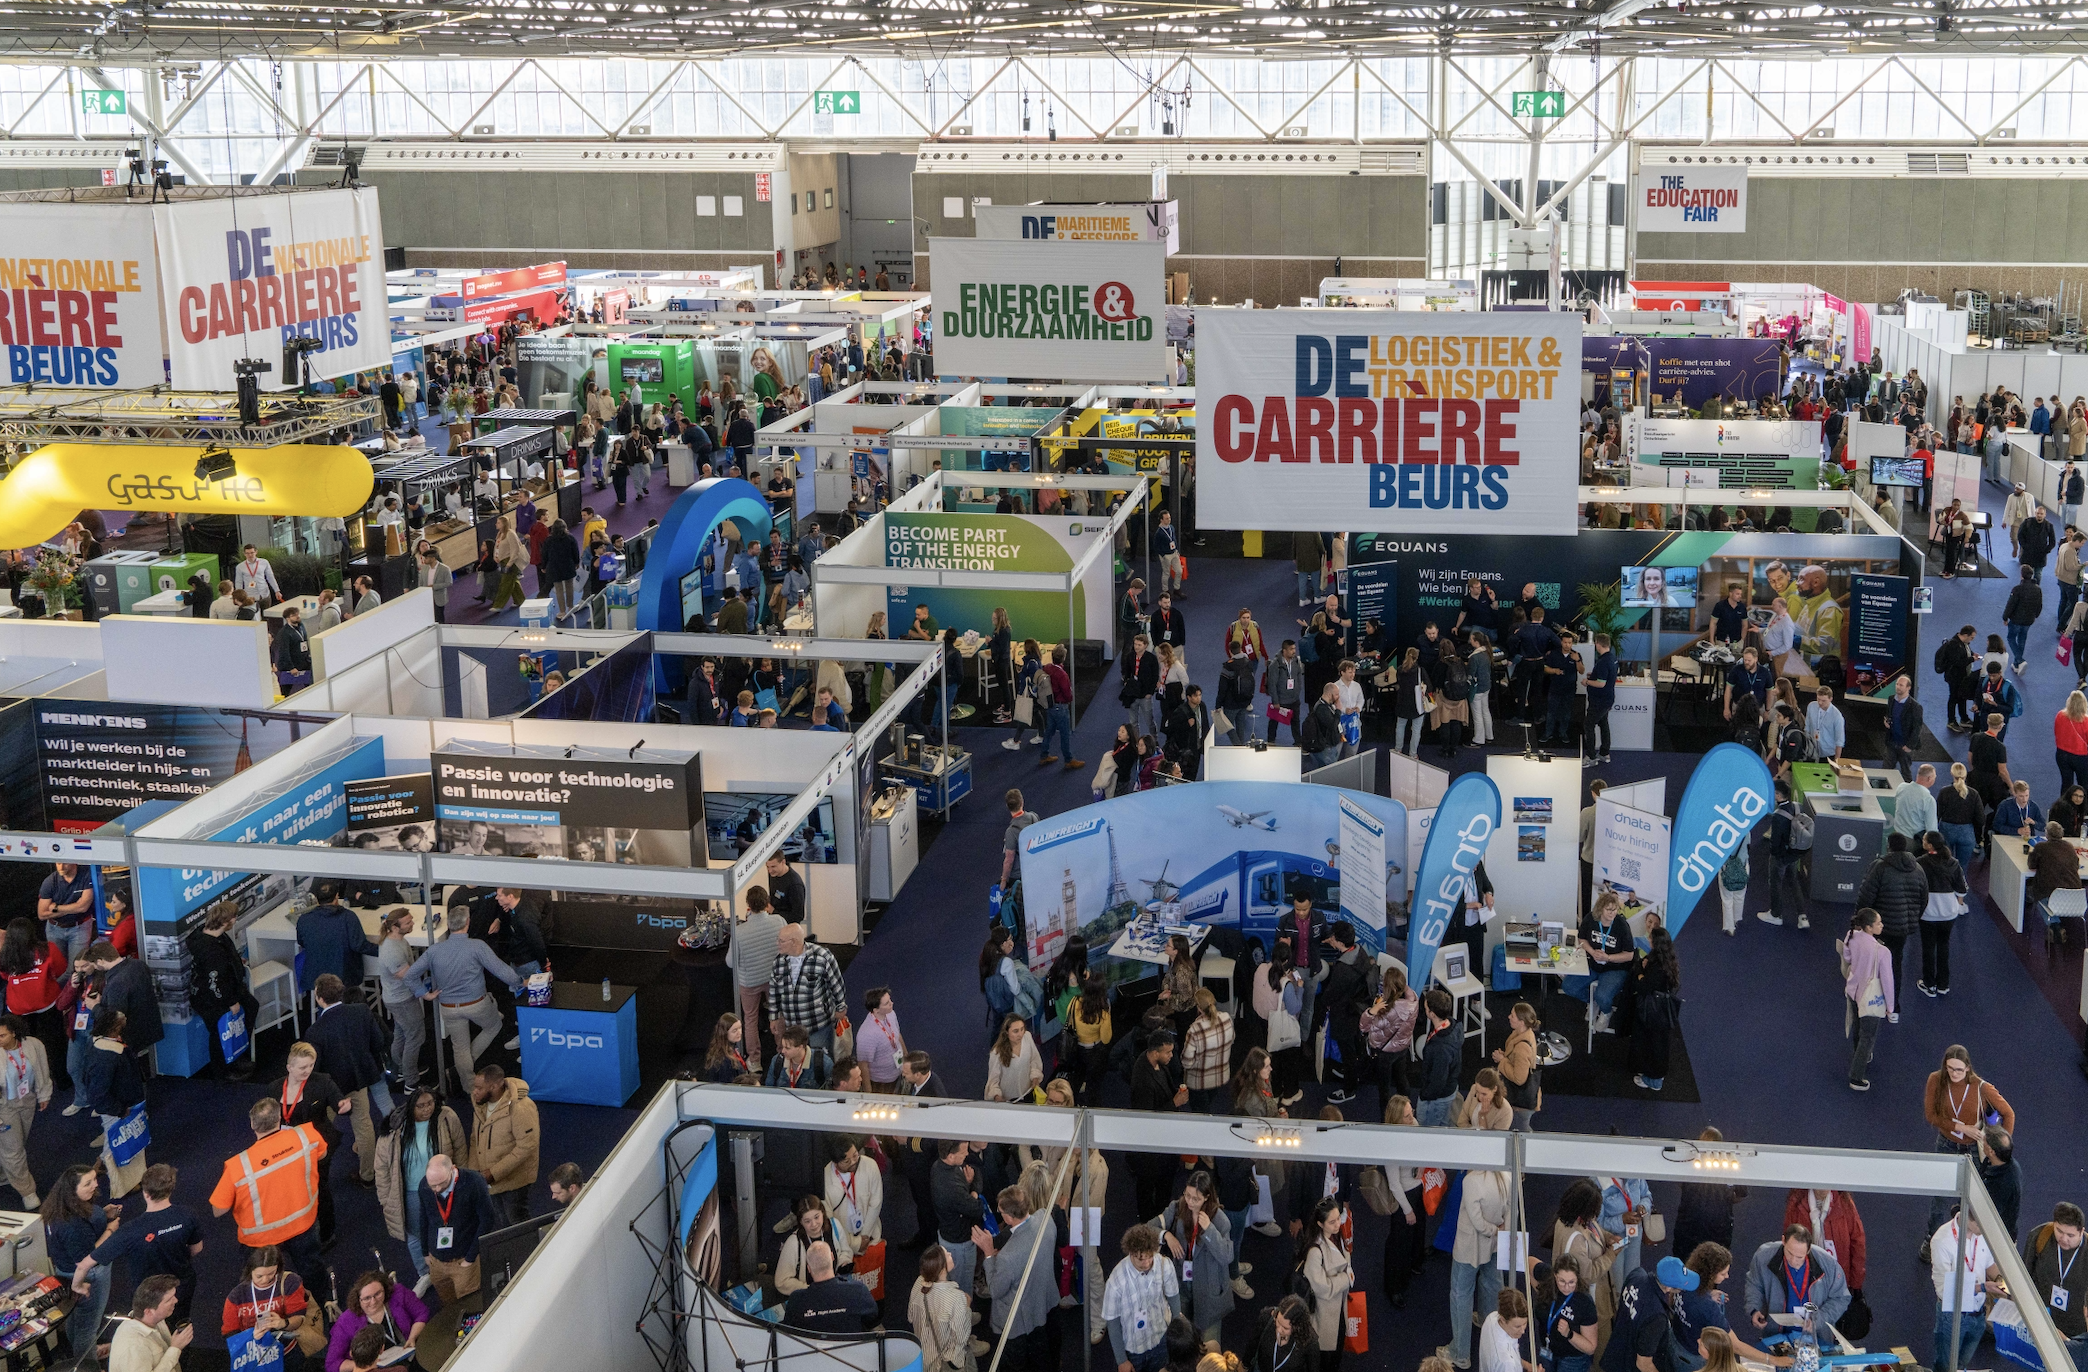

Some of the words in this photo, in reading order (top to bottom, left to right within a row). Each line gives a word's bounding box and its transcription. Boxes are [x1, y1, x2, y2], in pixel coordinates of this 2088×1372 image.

[1661, 176, 1684, 189] THE
[1647, 188, 1738, 207] EDUCATION
[1684, 207, 1718, 221] FAIR
[1057, 216, 1130, 231] MARITIEME
[226, 227, 275, 281] DE
[274, 234, 371, 274] NATIONALE
[0, 258, 141, 292] NATIONALE
[180, 258, 361, 344] CARRIÈRE
[960, 283, 1089, 316] ENERGIE
[1102, 286, 1127, 318] &
[468, 308, 486, 317] Connect
[486, 306, 495, 314] with
[943, 312, 1153, 342] DUURZAAMHEID
[10, 345, 119, 386] BEURS
[1296, 335, 1369, 398] DE
[1370, 335, 1532, 367] LOGISTIEK
[1538, 337, 1562, 367] &
[1659, 368, 1716, 376] carrière-advies.
[1369, 369, 1558, 399] TRANSPORT
[1107, 425, 1134, 435] CHEQUE
[1213, 380, 1519, 465] CARRIÈRE
[511, 438, 542, 458] DRINKS
[1108, 456, 1135, 467] EXPERIENCE
[420, 467, 458, 491] DRINKS
[1369, 464, 1508, 509] BEURS
[889, 526, 959, 541] BECOME
[964, 528, 1007, 542] PART
[889, 542, 912, 555] OF
[916, 542, 948, 556] THE
[953, 543, 1021, 558] ENERGY
[1376, 541, 1448, 553] EQUANS
[890, 556, 994, 570] TRANSITION
[1418, 569, 1435, 580] Wij
[1438, 570, 1457, 581] zijn
[1461, 570, 1504, 580] Equans.
[1418, 583, 1439, 592] Wie
[1442, 584, 1462, 593] ben
[41, 712, 147, 729] MENNENS
[45, 739, 68, 750] Wil
[70, 740, 84, 753] je
[87, 741, 142, 754] werken
[146, 744, 163, 758] bij
[166, 746, 186, 757] de
[48, 759, 135, 772] marktleider
[138, 762, 151, 773] in
[154, 763, 188, 777] hijs-
[191, 767, 210, 777] en
[49, 775, 144, 792] heftechniek,
[441, 764, 503, 782] Passie
[508, 770, 553, 784] voor
[558, 770, 674, 792] technologie
[51, 795, 70, 804] en
[350, 793, 386, 803] Passie
[388, 790, 414, 798] voor
[442, 786, 465, 798] en
[471, 784, 571, 803] innovatie?
[263, 801, 299, 832] naar
[304, 782, 332, 807] een
[350, 800, 402, 813] innovatie
[367, 806, 419, 819] robotica?
[460, 809, 474, 818] zijn
[476, 810, 488, 819] wij
[540, 814, 555, 822] jou!
[282, 793, 346, 840] uitdagin
[1614, 813, 1651, 831] dnata
[1027, 818, 1101, 851] MAINFREIGHT
[1605, 828, 1627, 842] Now
[1630, 835, 1658, 853] hiring!
[1677, 786, 1766, 893] dnata
[745, 849, 765, 874] Blueprint
[765, 821, 790, 850] Automation
[186, 907, 207, 924] Werk
[230, 874, 264, 901] toekomst
[648, 914, 686, 929] bpa
[548, 1029, 603, 1049] bpa
[272, 1146, 294, 1159] Strukton
[158, 1224, 182, 1236] Strukton
